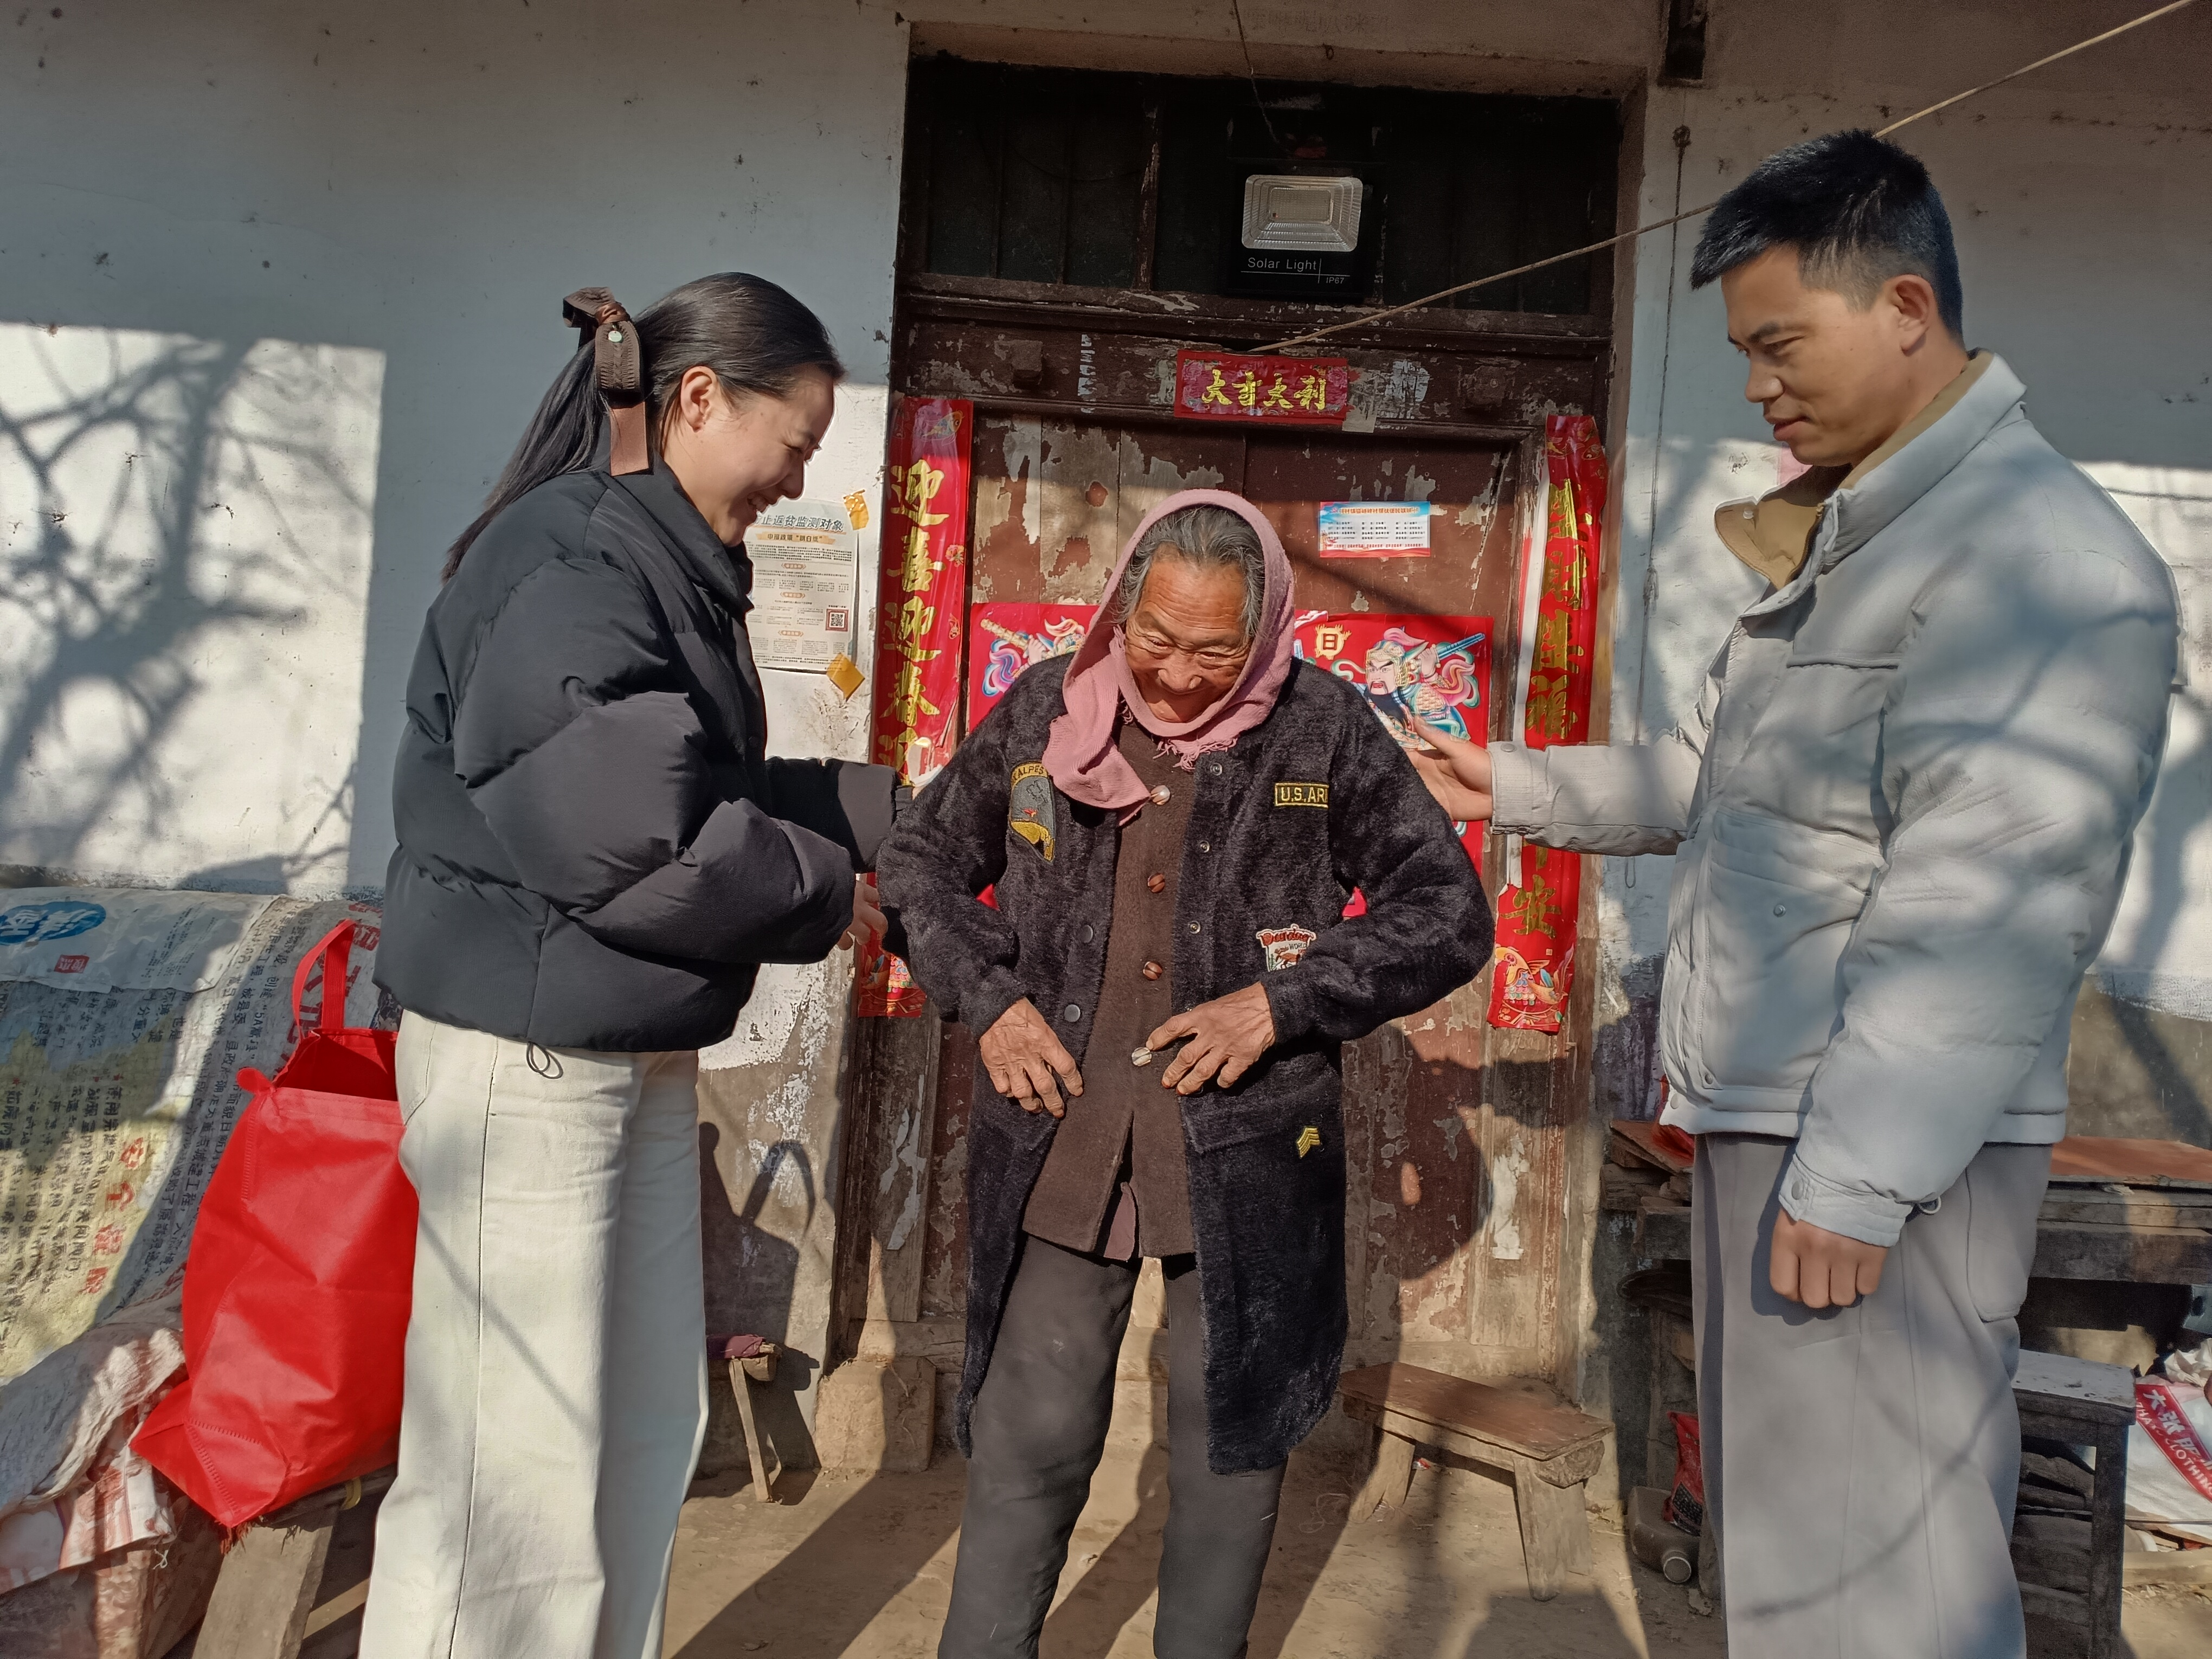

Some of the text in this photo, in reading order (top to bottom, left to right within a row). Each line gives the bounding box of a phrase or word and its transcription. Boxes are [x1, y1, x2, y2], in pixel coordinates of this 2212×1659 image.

[1248, 258, 1316, 272] Solar Light
[1201, 369, 1327, 410] 大吉大利
[1323, 633, 1338, 651] 日
